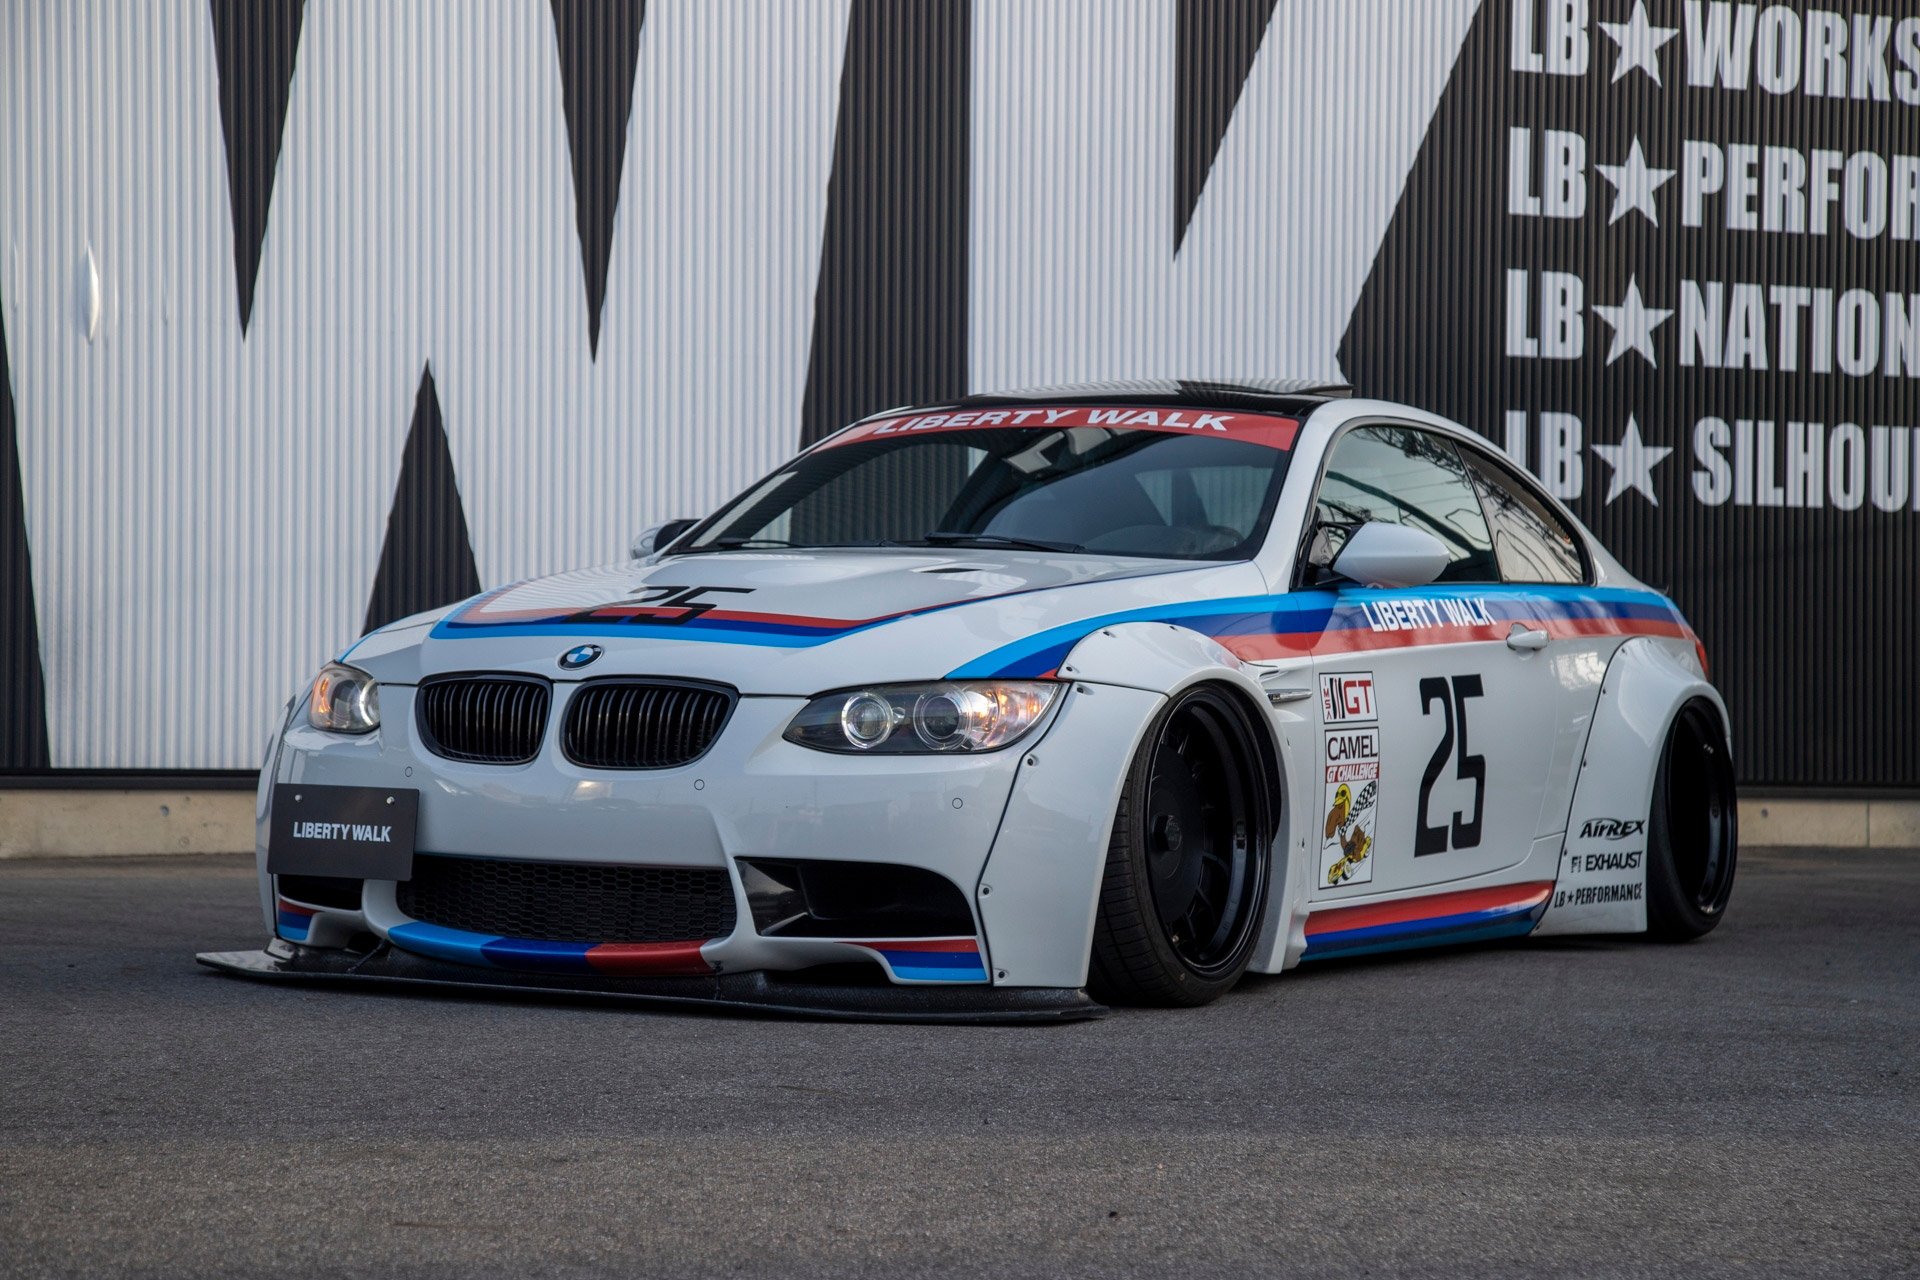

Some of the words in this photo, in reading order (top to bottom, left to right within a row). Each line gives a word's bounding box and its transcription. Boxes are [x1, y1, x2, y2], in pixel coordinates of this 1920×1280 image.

[1510, 0, 1590, 76] LB
[1684, 0, 1920, 106] WORKS
[1508, 126, 1587, 219] LB
[1682, 139, 1920, 242] PERFOR
[1506, 268, 1584, 360] LB
[1679, 278, 1920, 378] NATION
[872, 408, 1081, 435] LIBERTY
[1086, 409, 1236, 432] WALK
[1691, 416, 1920, 513] SILHOU
[560, 585, 757, 625] 25
[1360, 599, 1443, 632] LIBERTY
[1439, 598, 1497, 628] WALK
[1343, 680, 1372, 715] GT
[1327, 734, 1378, 762] CAMEL
[1327, 766, 1338, 783] GT
[1337, 763, 1378, 782] CHALLENGE
[1414, 674, 1486, 858] 25
[293, 821, 350, 841] LIBERTY
[351, 824, 392, 843] WALK
[1585, 850, 1643, 872] EXHAUST
[1554, 890, 1567, 908] LB
